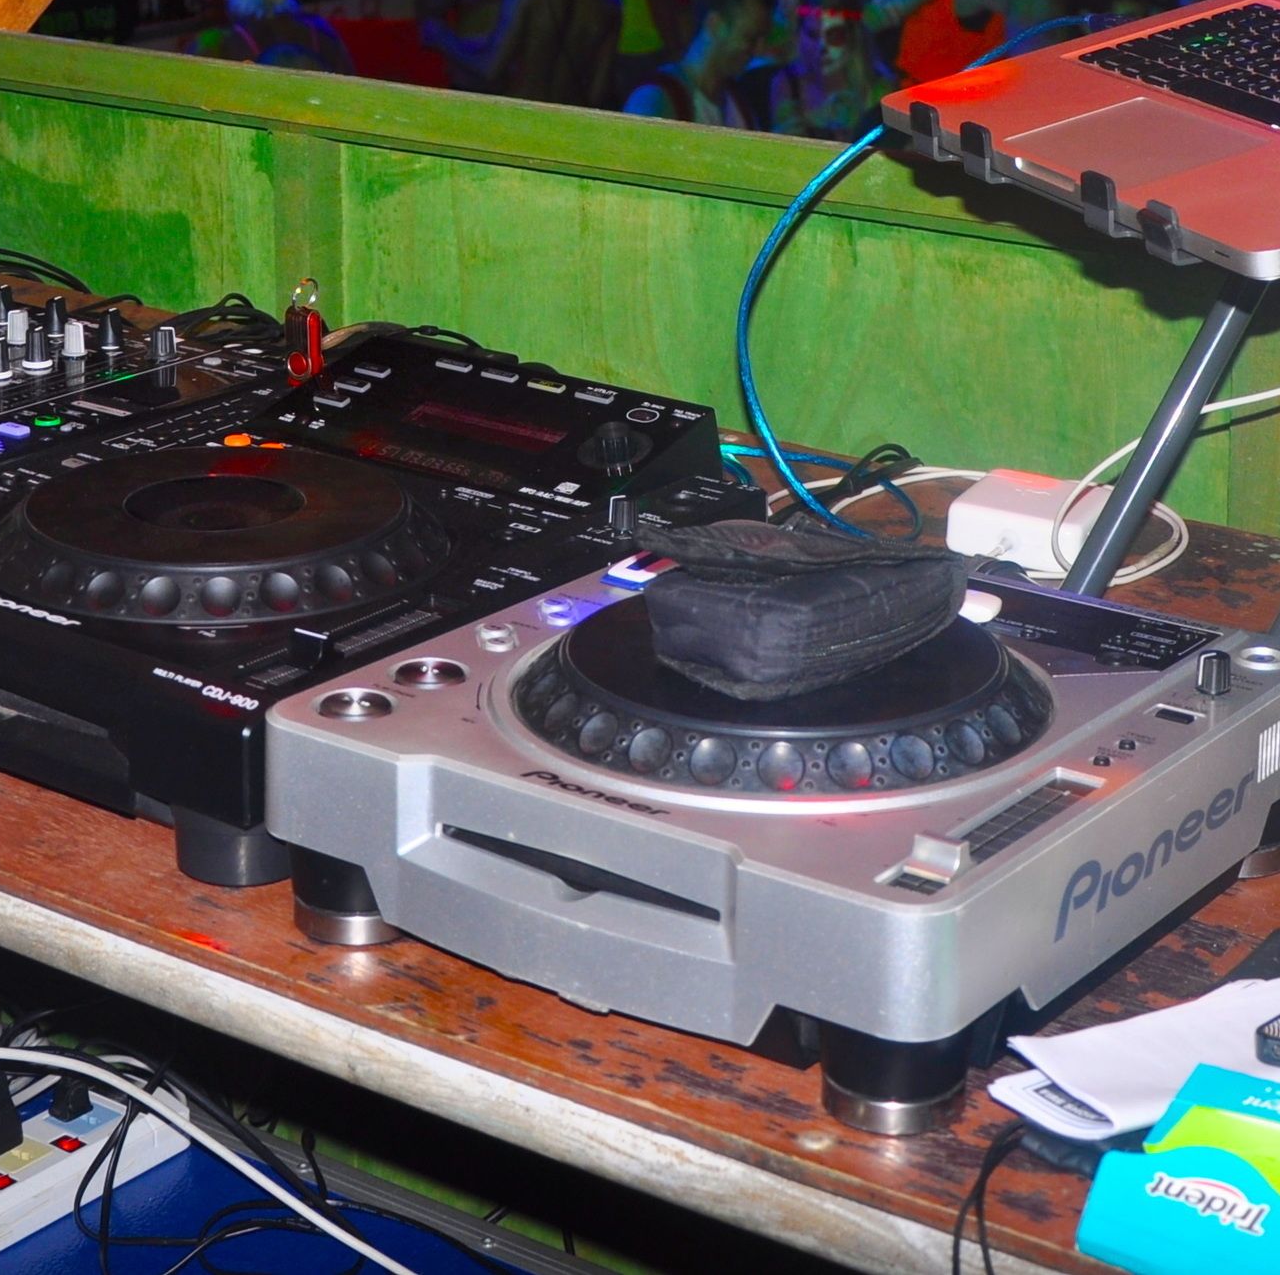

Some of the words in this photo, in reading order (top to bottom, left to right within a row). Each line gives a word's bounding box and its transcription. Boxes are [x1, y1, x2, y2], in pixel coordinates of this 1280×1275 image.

[201, 684, 260, 711] CDJ-900
[520, 771, 671, 815] Pioneer
[1054, 770, 1255, 944] Pioneer
[1148, 1174, 1268, 1235] Trident
